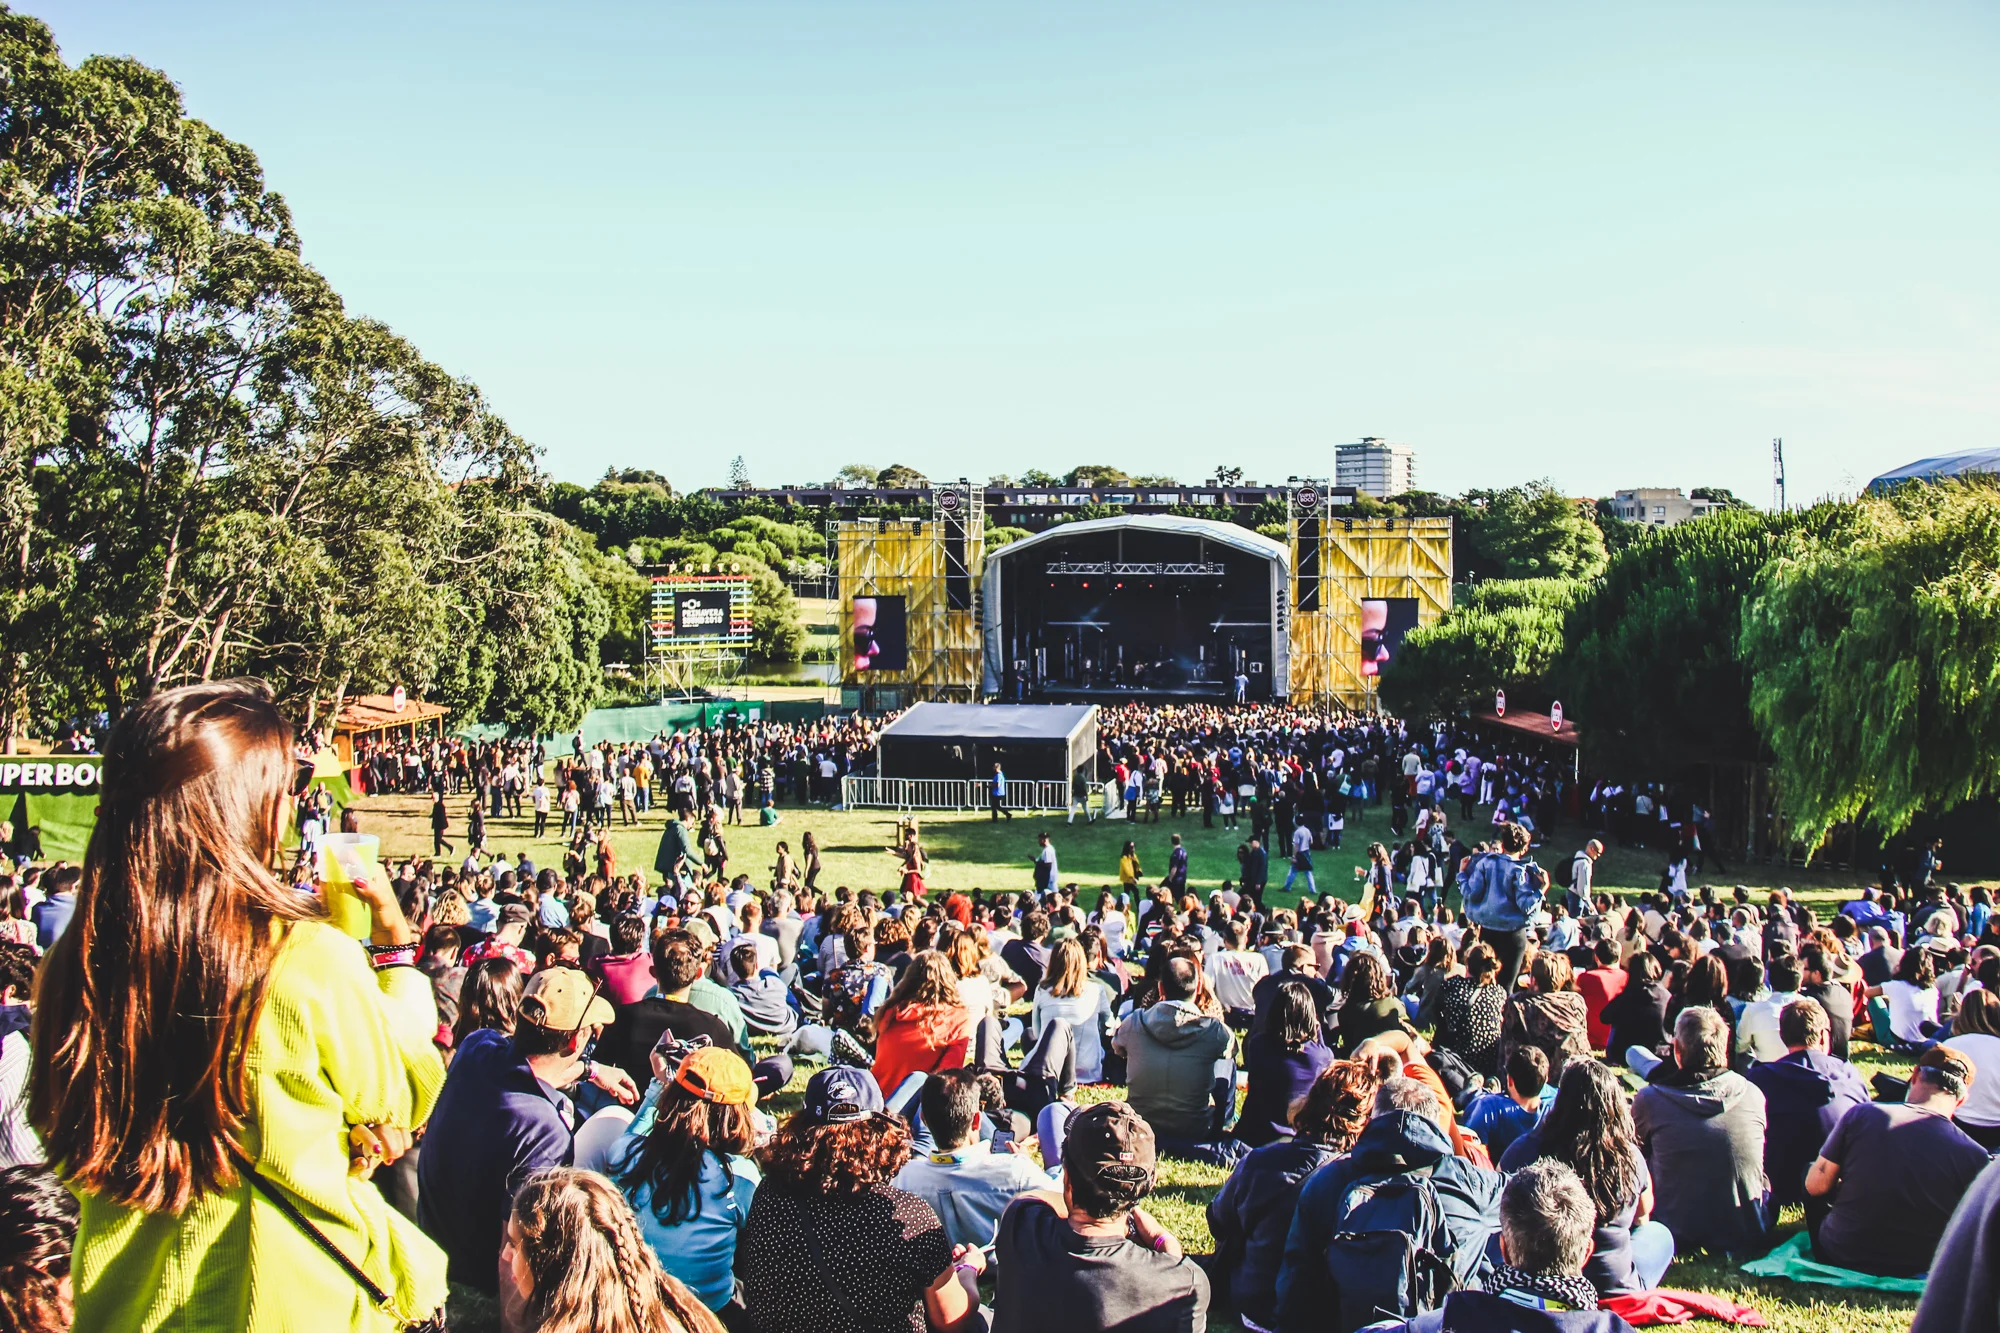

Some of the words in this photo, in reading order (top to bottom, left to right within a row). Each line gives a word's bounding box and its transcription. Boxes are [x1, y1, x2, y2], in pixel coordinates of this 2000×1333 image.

[669, 563, 740, 573] PORTO
[682, 599, 701, 609] NOS
[0, 763, 53, 786] PER
